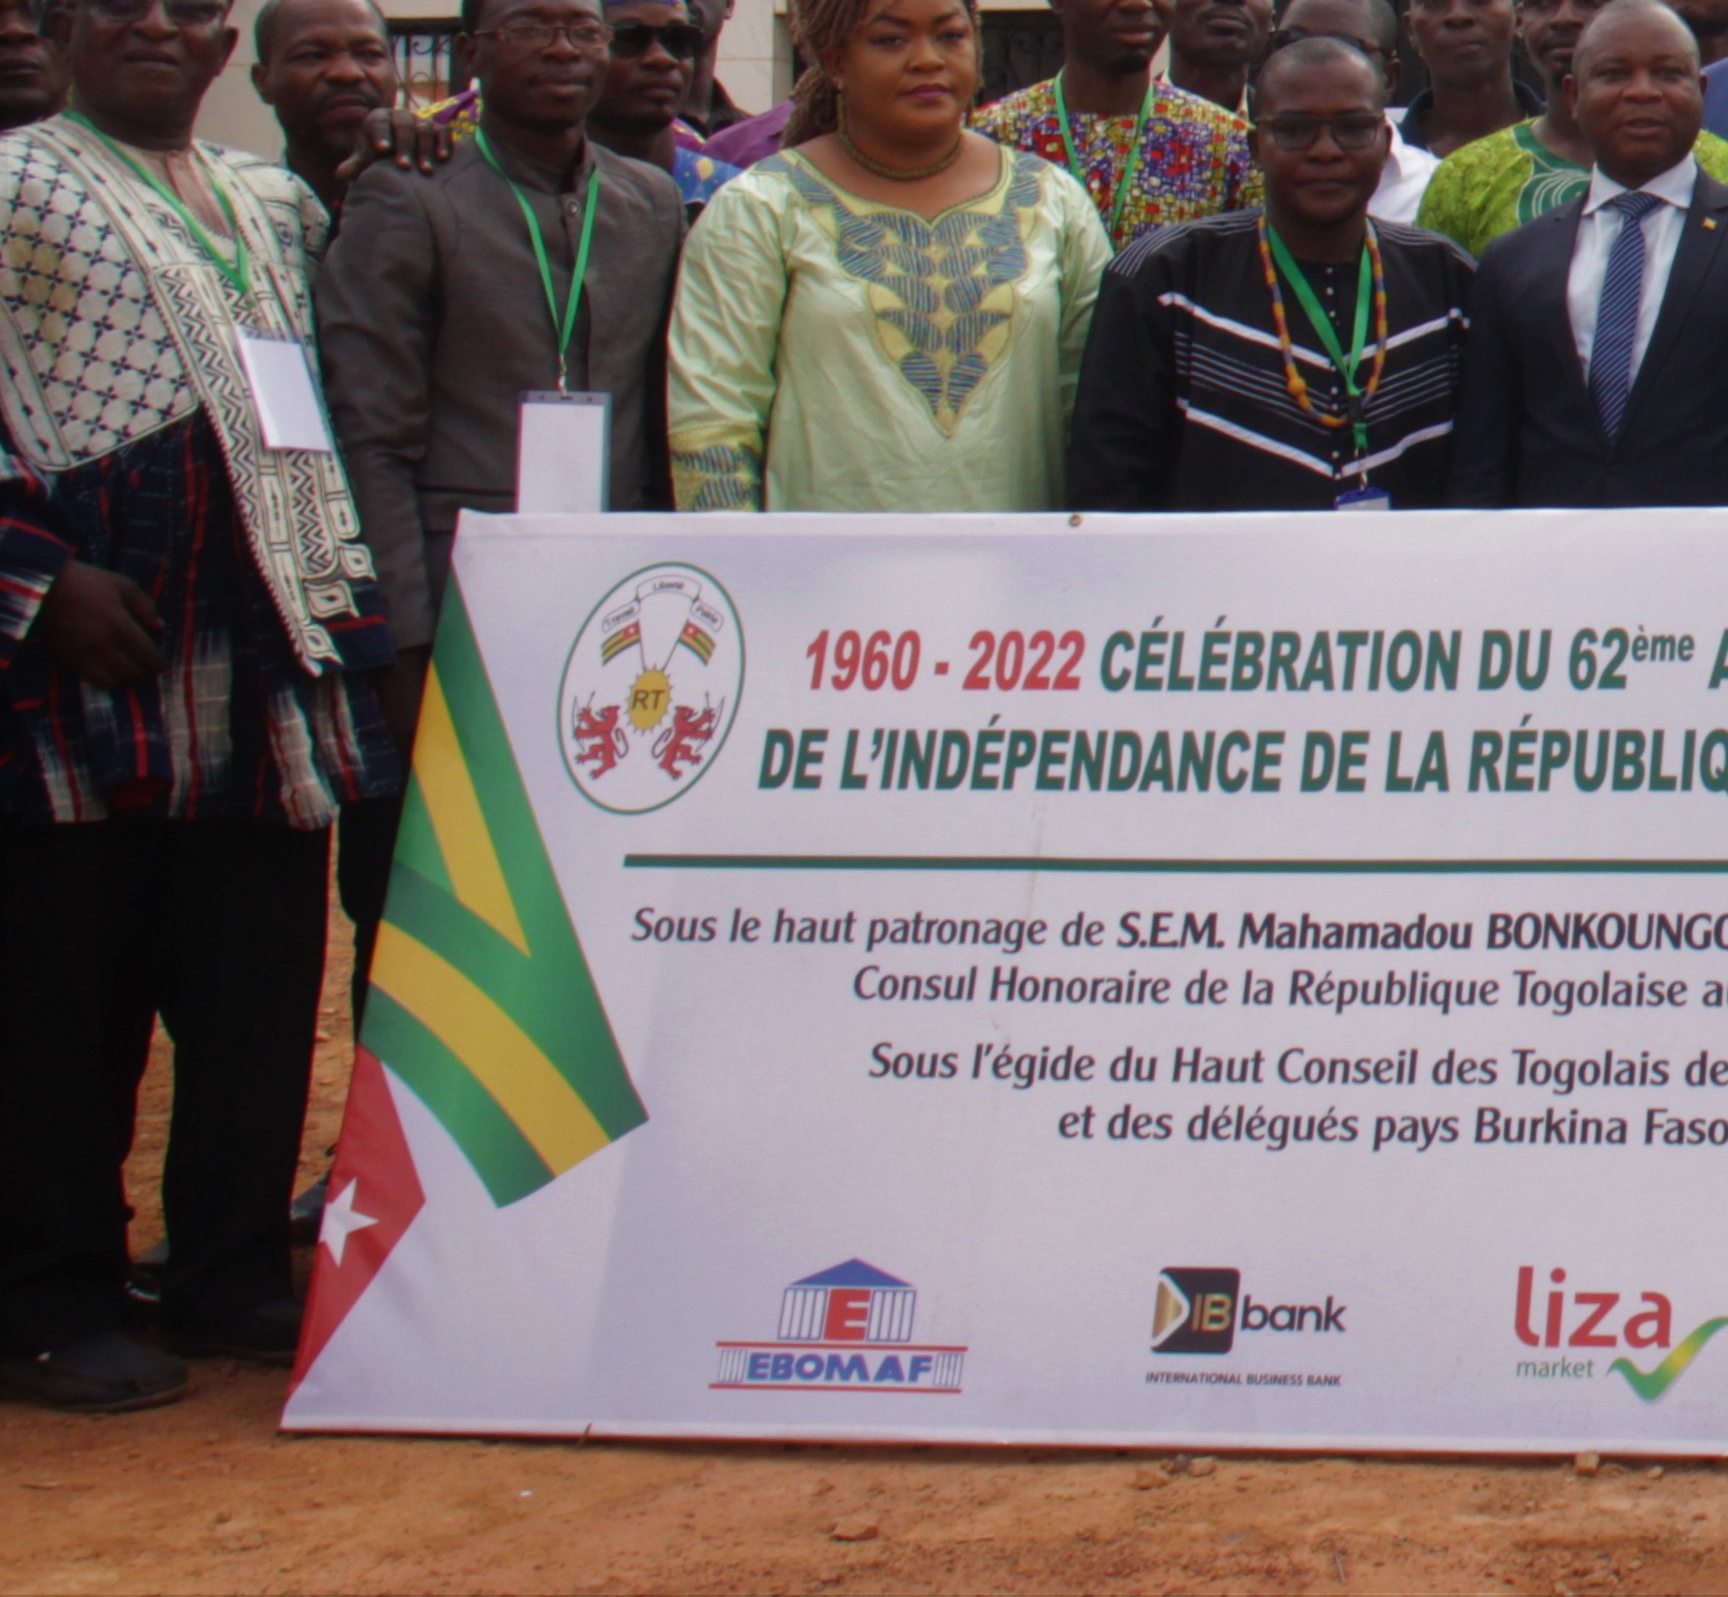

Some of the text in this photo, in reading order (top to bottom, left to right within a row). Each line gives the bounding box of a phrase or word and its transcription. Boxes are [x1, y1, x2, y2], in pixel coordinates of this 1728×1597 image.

[807, 630, 920, 691] 1960
[962, 630, 1085, 691] 2022
[1100, 616, 1462, 692] CÉLÉBRATION
[1478, 629, 1552, 691] DU
[633, 690, 664, 710] RT
[758, 729, 828, 789] DE
[840, 714, 1285, 793] L'INDÉPENDANCE
[1300, 731, 1370, 792] DE
[1385, 731, 1449, 792] LA
[632, 907, 717, 942] Sous
[730, 908, 761, 942] le
[774, 909, 856, 943] haut
[866, 912, 1047, 954] patronage
[1061, 912, 1104, 946] de
[1117, 912, 1224, 948] S.E.M.
[1239, 913, 1472, 949] Mahamadou
[854, 965, 977, 1001] Consul
[990, 966, 1170, 1004] Honoraire
[1185, 970, 1228, 1004] de
[1242, 970, 1273, 1005] la
[1289, 970, 1499, 1015] République
[1514, 970, 1687, 1016] Togolaise
[869, 1042, 958, 1078] Sous
[972, 1044, 1095, 1089] l'égide
[1110, 1046, 1157, 1082] du
[1173, 1047, 1264, 1083] Haut
[1278, 1048, 1418, 1084] Conseil
[1432, 1049, 1497, 1085] des
[1512, 1049, 1669, 1095] Togolais
[1059, 1106, 1095, 1139] et
[1108, 1104, 1172, 1140] des
[1187, 1105, 1358, 1151] délégués
[1373, 1116, 1459, 1152] pays
[1475, 1107, 1627, 1144] Burkina
[1241, 1295, 1345, 1332] bank
[1515, 1266, 1672, 1349] liza
[747, 1353, 933, 1382] EBOMAF
[1146, 1372, 1341, 1386] INTERNATIONAL BUSINESS BANK
[1517, 1357, 1594, 1379] market
